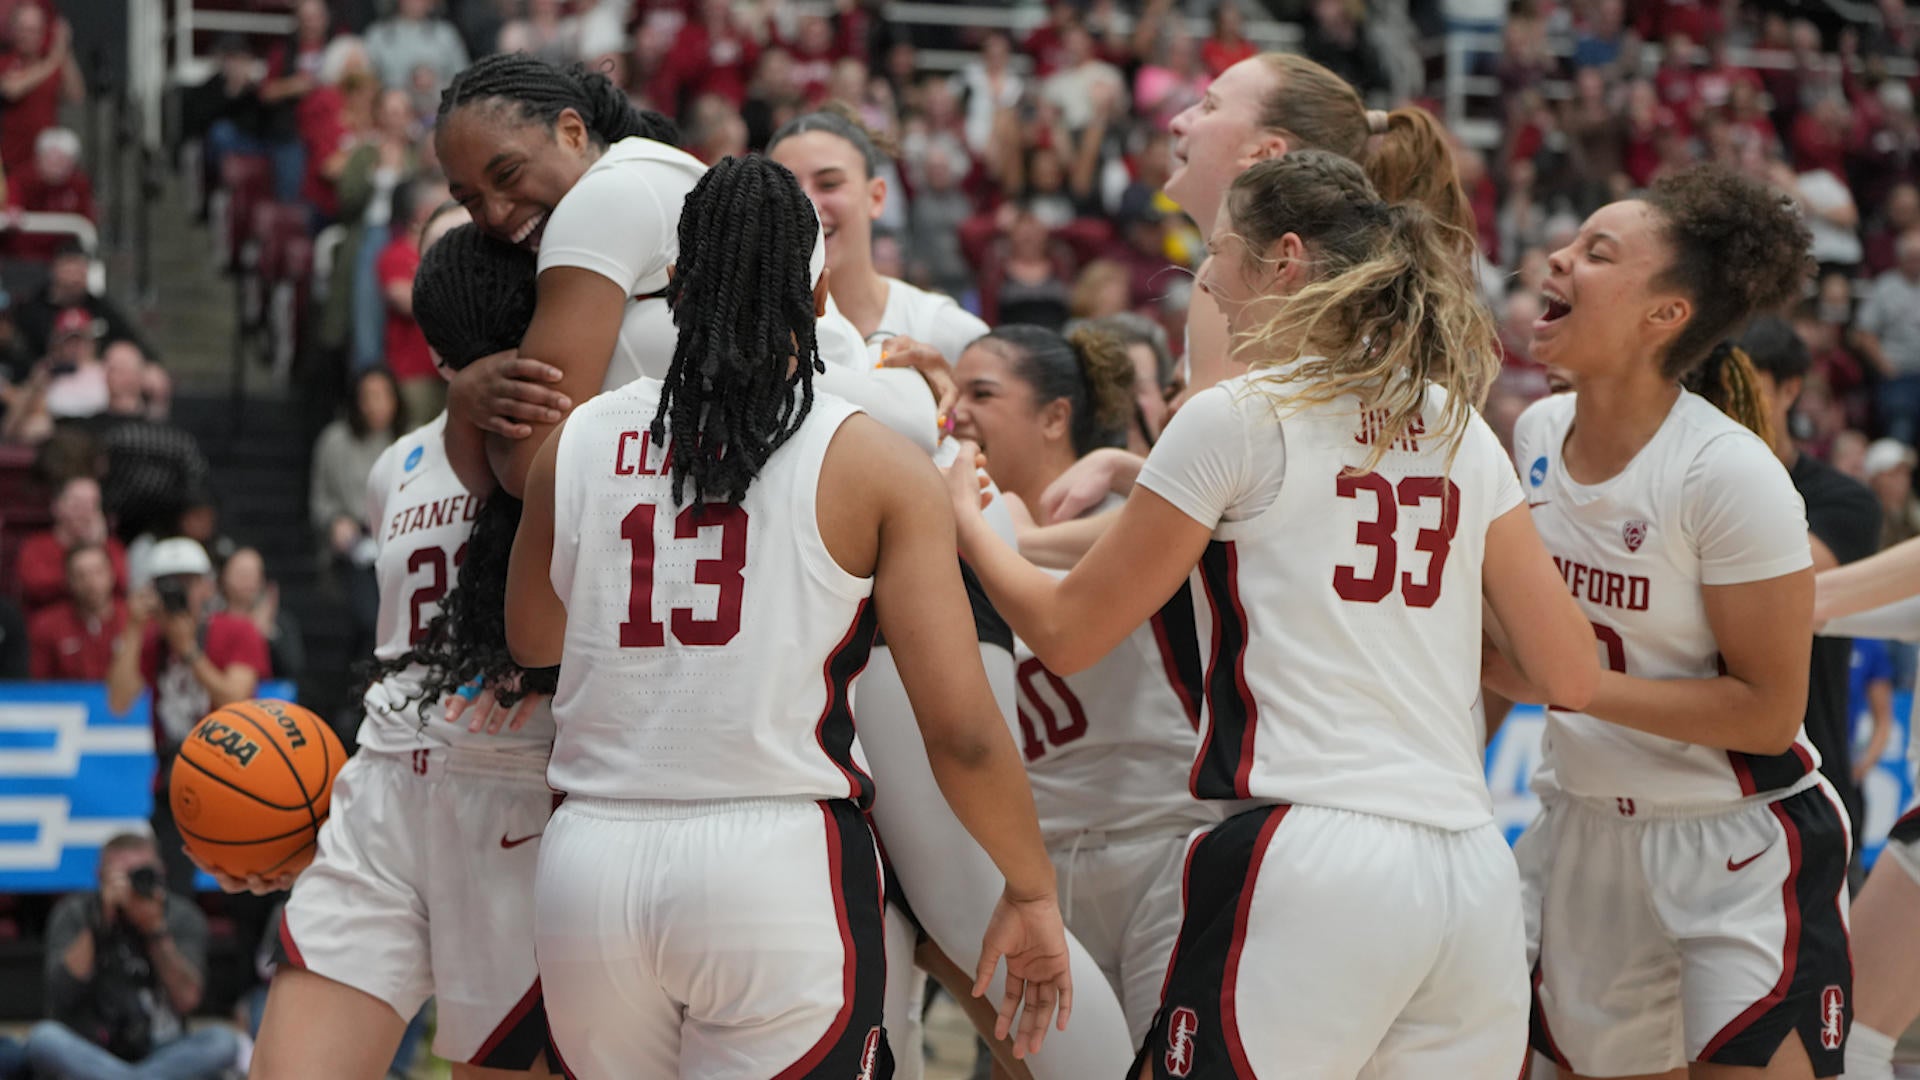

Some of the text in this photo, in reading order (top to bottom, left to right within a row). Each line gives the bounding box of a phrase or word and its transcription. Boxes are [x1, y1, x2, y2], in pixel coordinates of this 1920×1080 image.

[408, 542, 471, 647] 2
[620, 503, 749, 648] 13
[1333, 466, 1460, 608] 33
[197, 719, 259, 769] NCAA
